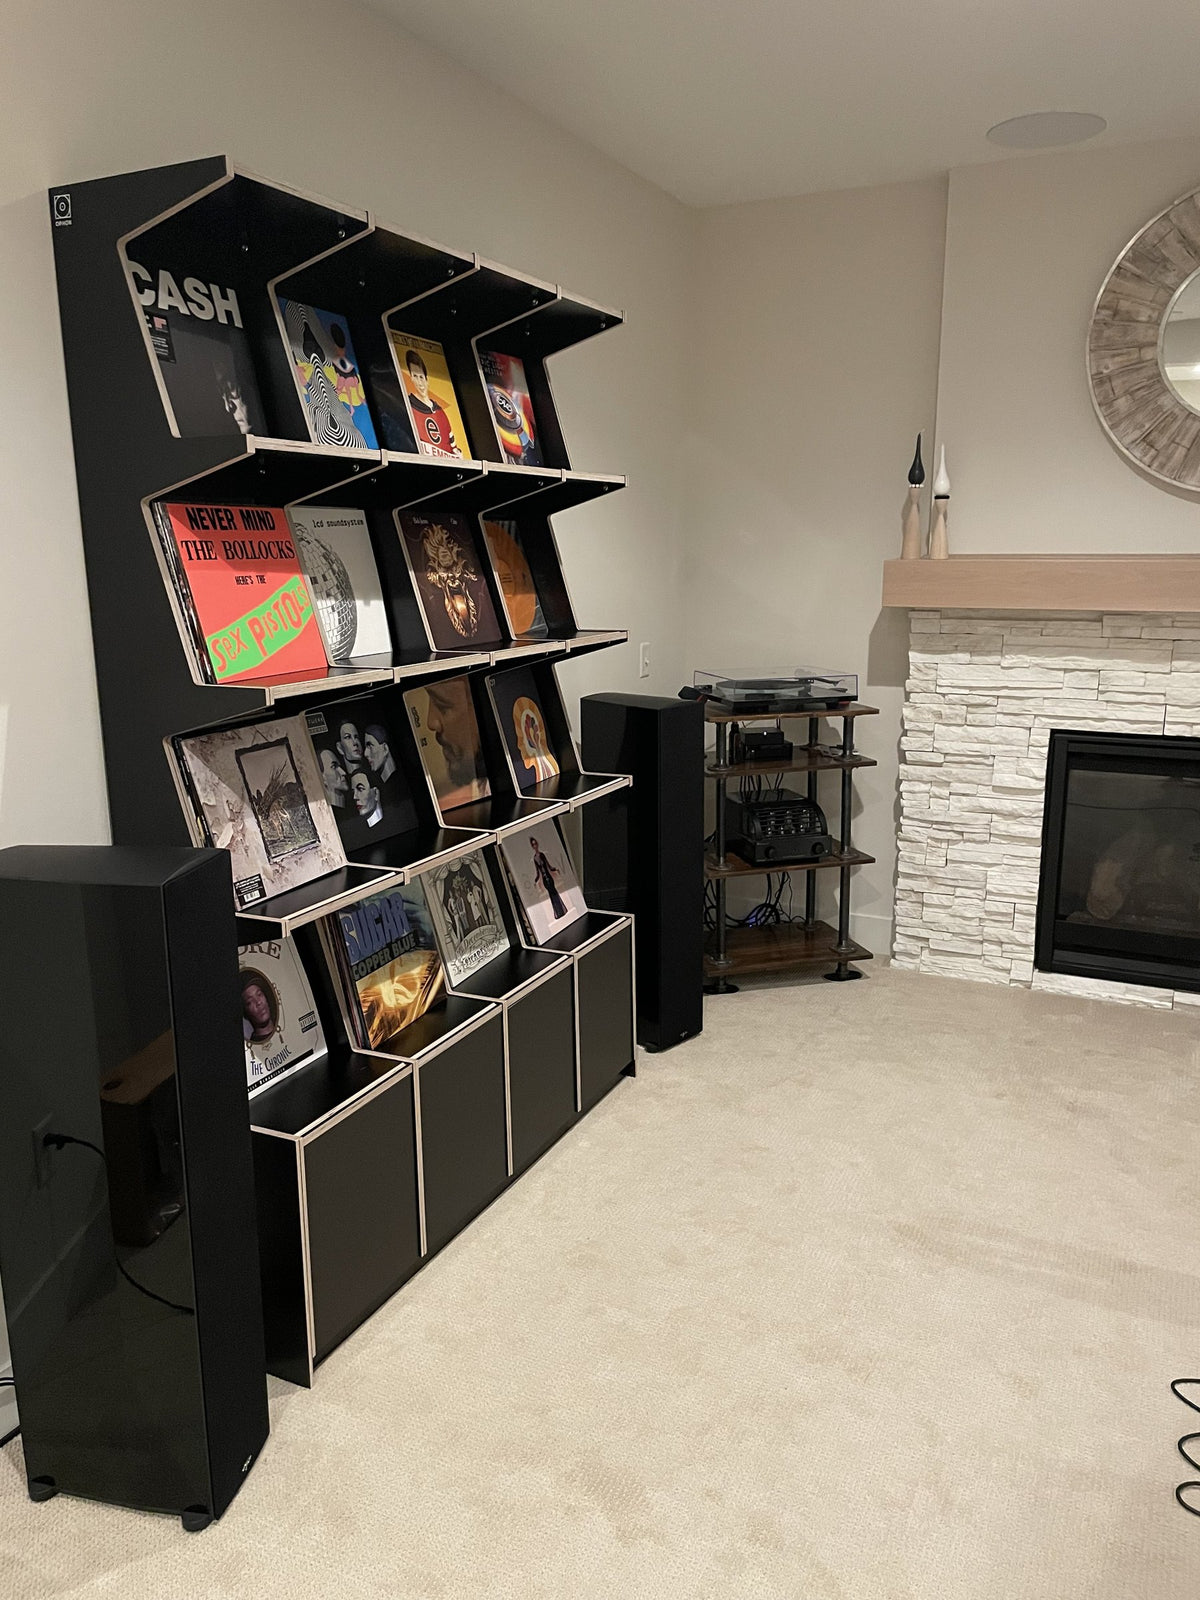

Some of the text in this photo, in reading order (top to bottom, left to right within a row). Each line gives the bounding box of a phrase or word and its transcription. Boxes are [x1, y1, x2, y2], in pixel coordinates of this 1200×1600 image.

[127, 260, 243, 329] CASH
[185, 507, 276, 531] NEVER MIND
[312, 519, 364, 528] lcd soundsystem
[181, 540, 295, 560] THE BOLLOCKS
[235, 575, 267, 586] HERE'S THE
[341, 892, 411, 965] SUGAR
[352, 932, 416, 979] COPPER BLUE
[250, 1045, 293, 1076] THE CHRONIC
